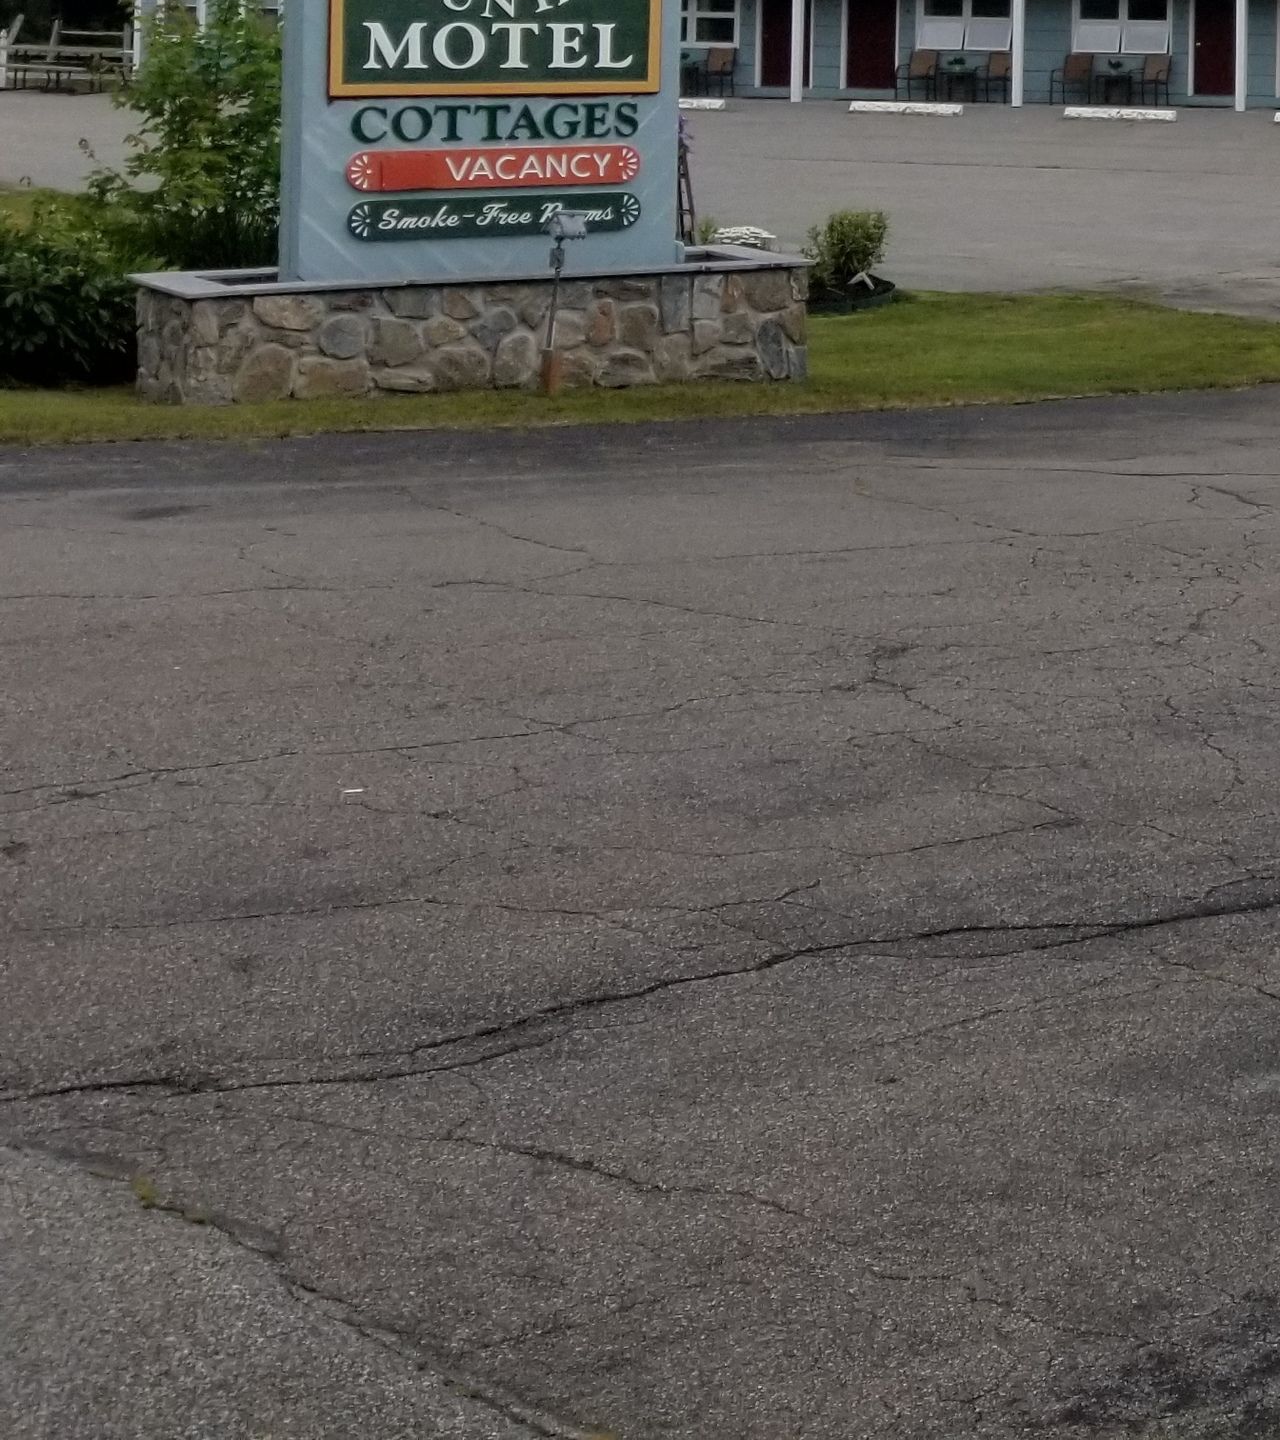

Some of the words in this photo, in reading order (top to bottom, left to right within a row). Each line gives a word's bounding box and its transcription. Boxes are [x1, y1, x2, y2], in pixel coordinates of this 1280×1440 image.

[362, 22, 633, 70] MOTEL
[350, 102, 640, 143] COTTAGES
[445, 152, 612, 181] VACANCY
[377, 202, 533, 230] Smoke-Free
[540, 202, 614, 224] Rms
